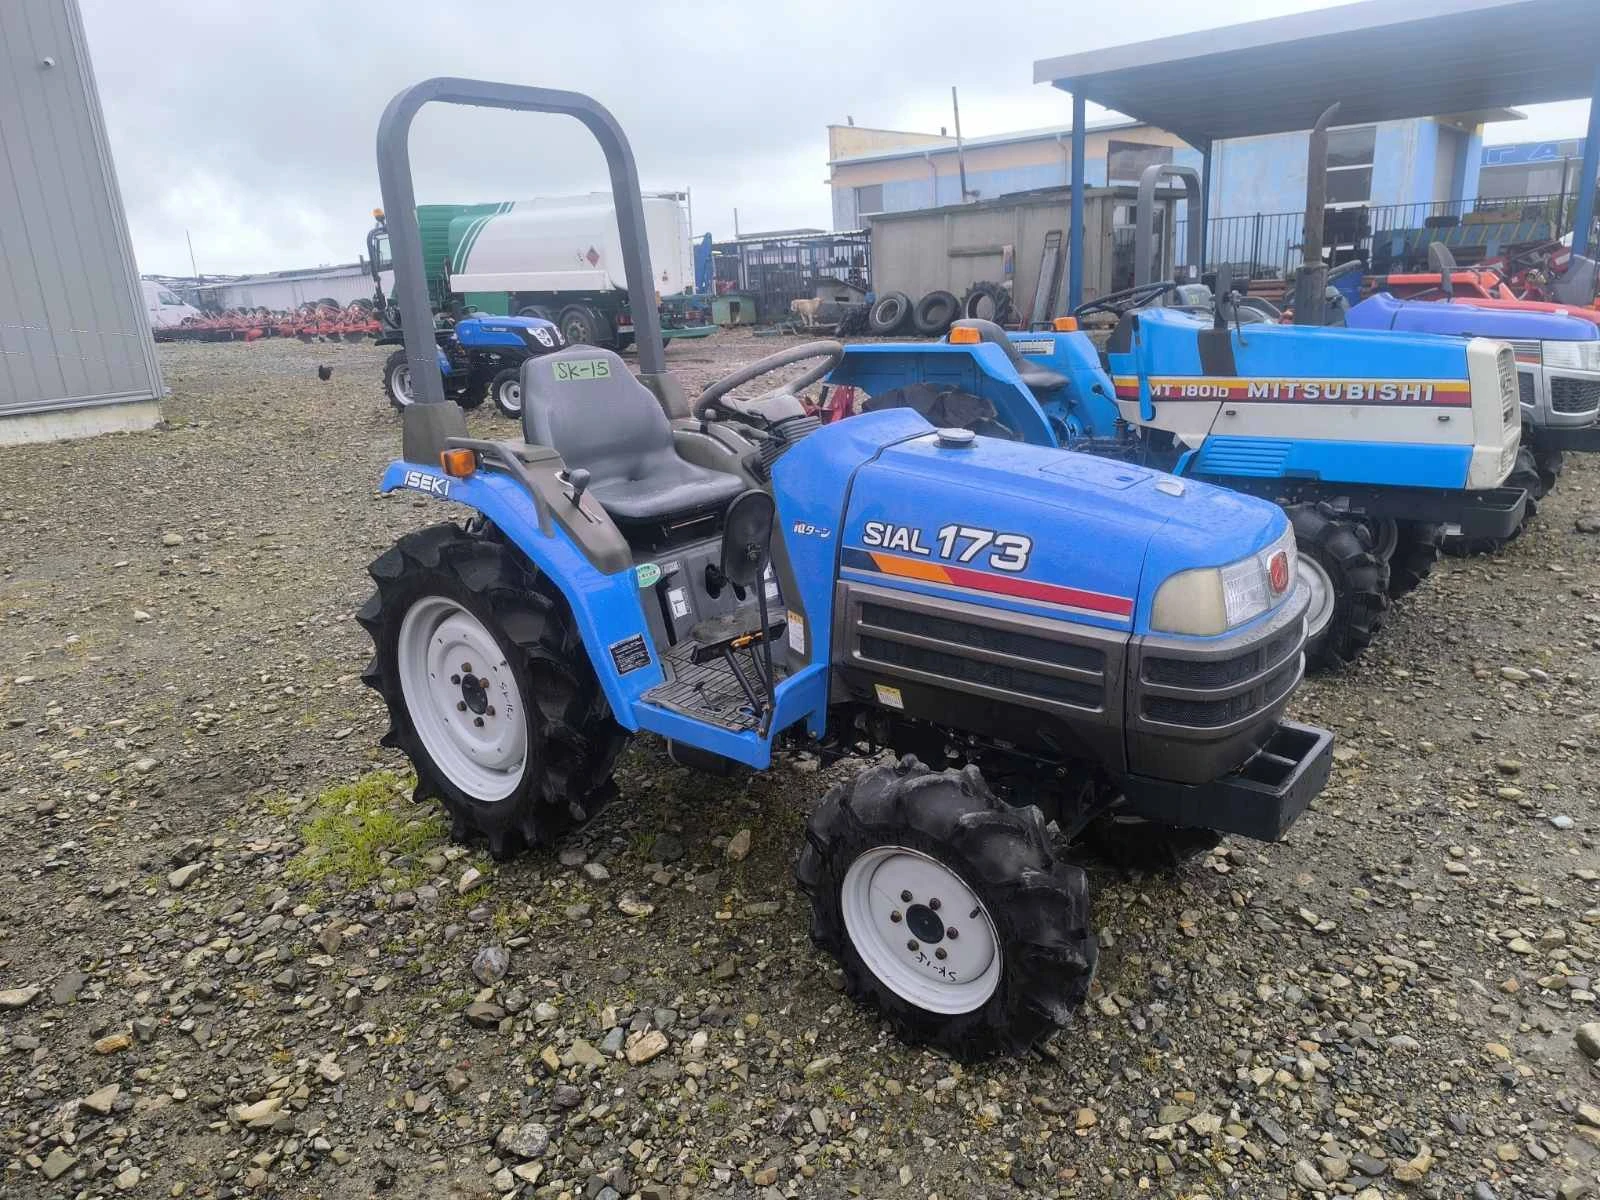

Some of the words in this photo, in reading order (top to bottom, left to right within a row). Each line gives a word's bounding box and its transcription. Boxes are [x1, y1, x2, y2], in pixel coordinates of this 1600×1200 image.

[556, 361, 609, 381] SK-15
[1246, 382, 1436, 402] MITSUBISHI
[403, 470, 451, 497] ISEKI
[862, 521, 931, 556] SIAL
[937, 523, 1033, 573] 173
